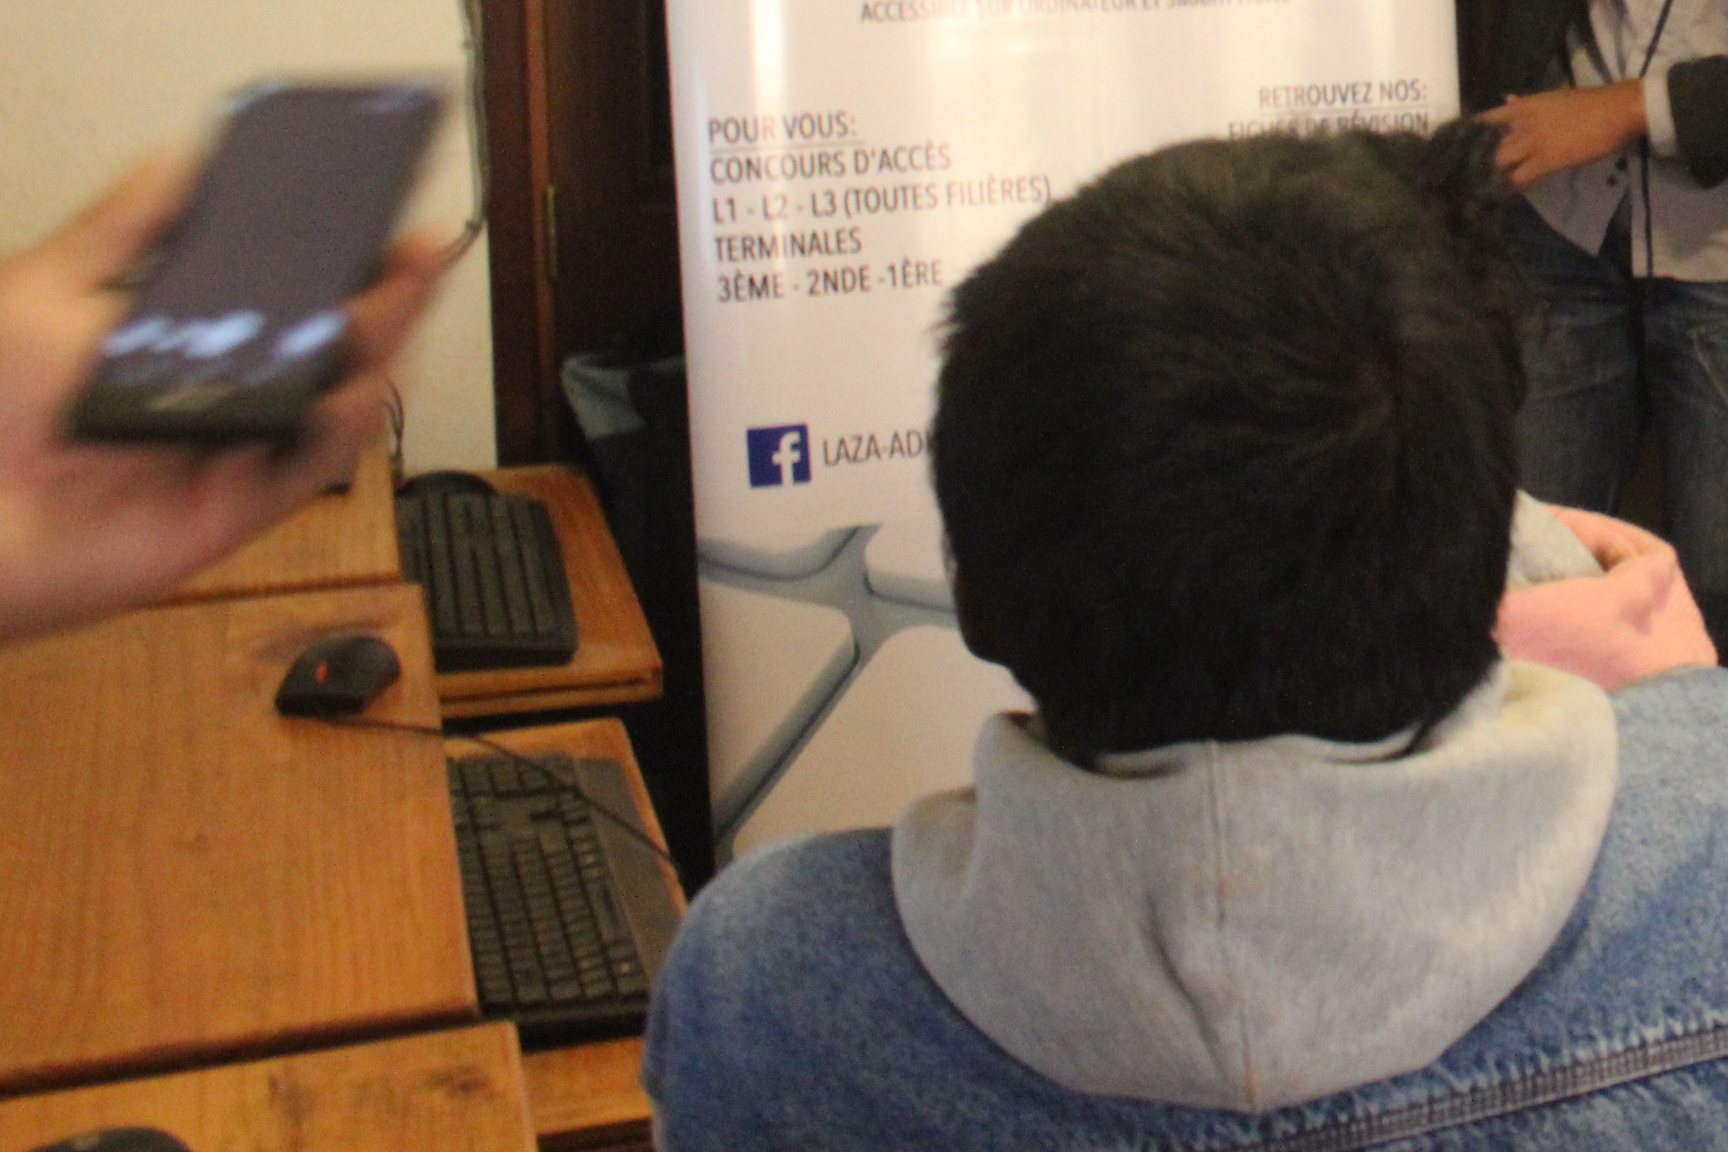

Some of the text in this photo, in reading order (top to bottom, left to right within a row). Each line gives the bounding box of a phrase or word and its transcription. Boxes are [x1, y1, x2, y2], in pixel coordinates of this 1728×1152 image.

[1258, 82, 1373, 108] RETROUVEZ
[709, 113, 775, 144] POUR
[710, 138, 953, 185] CONCOURS D'ACCÈS
[712, 195, 738, 224] L1
[761, 192, 788, 222] L2
[810, 189, 837, 219] L3
[844, 180, 938, 219] (TOUTES
[714, 226, 863, 264] TERMINALES
[806, 264, 872, 298] 2NDE
